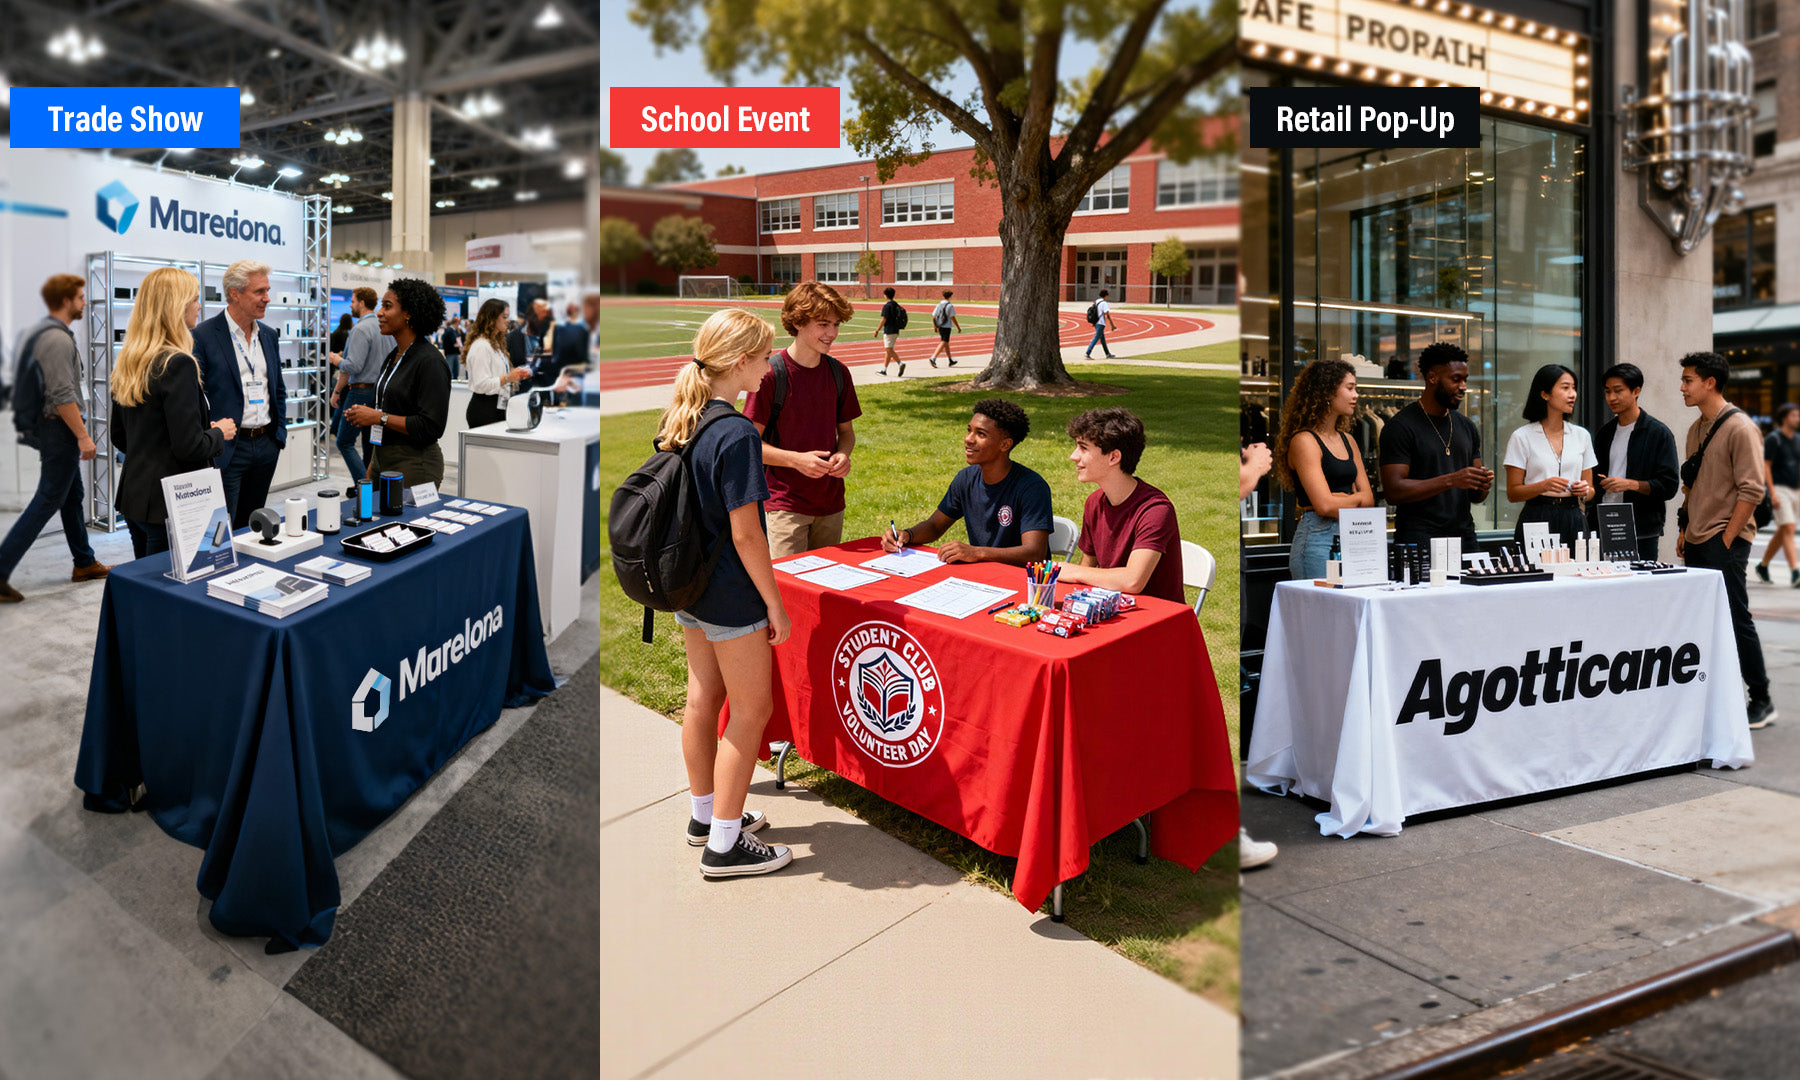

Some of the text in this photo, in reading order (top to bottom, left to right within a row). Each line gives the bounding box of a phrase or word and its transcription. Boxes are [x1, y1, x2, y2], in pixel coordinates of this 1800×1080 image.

[399, 604, 503, 702] Marelona
[838, 628, 936, 692] STUDENT CLUB
[842, 701, 932, 761] VOLUNTEER DAY
